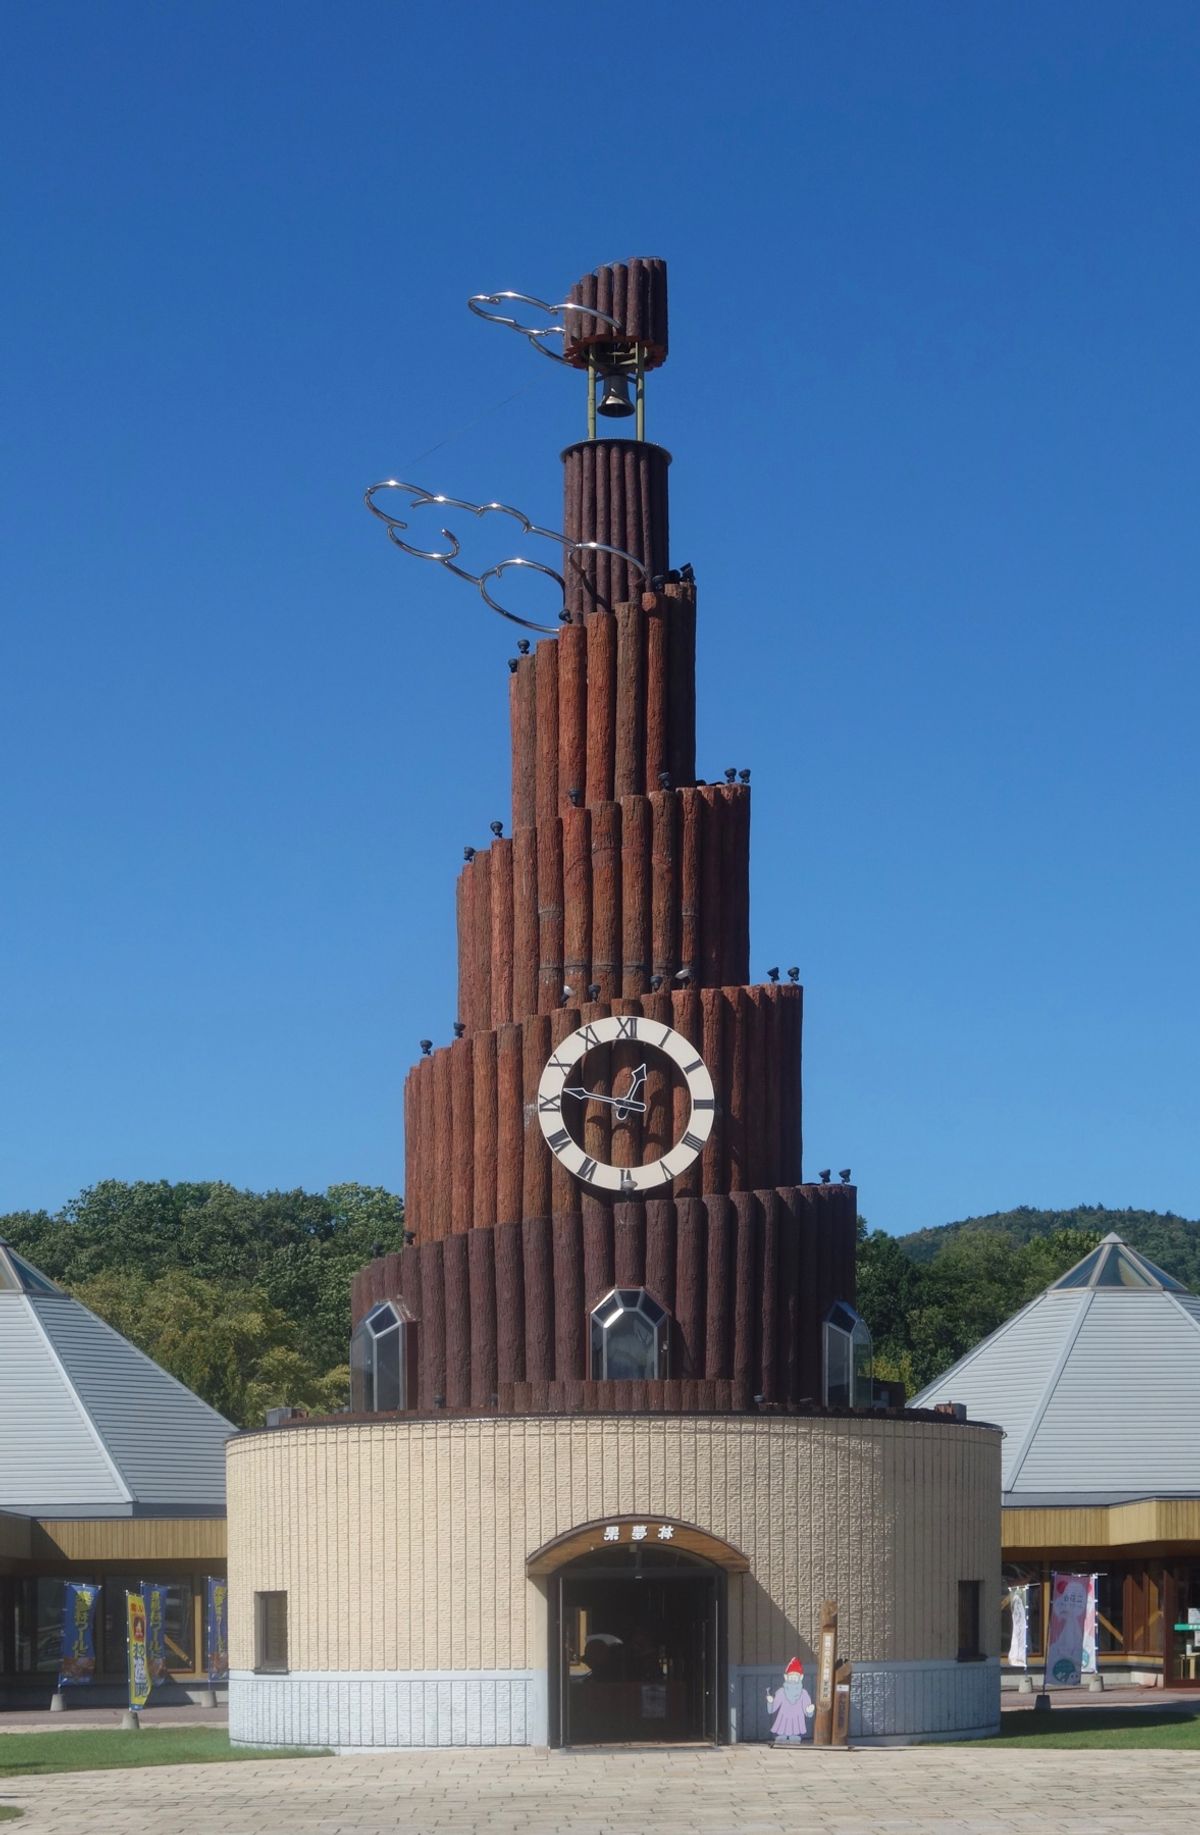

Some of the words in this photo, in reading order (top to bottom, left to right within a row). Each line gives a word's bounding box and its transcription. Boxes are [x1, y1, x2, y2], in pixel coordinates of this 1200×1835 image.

[576, 1025, 601, 1050] XI
[615, 1017, 638, 1039] XII
[548, 1054, 572, 1076] X
[539, 1094, 561, 1112] IX
